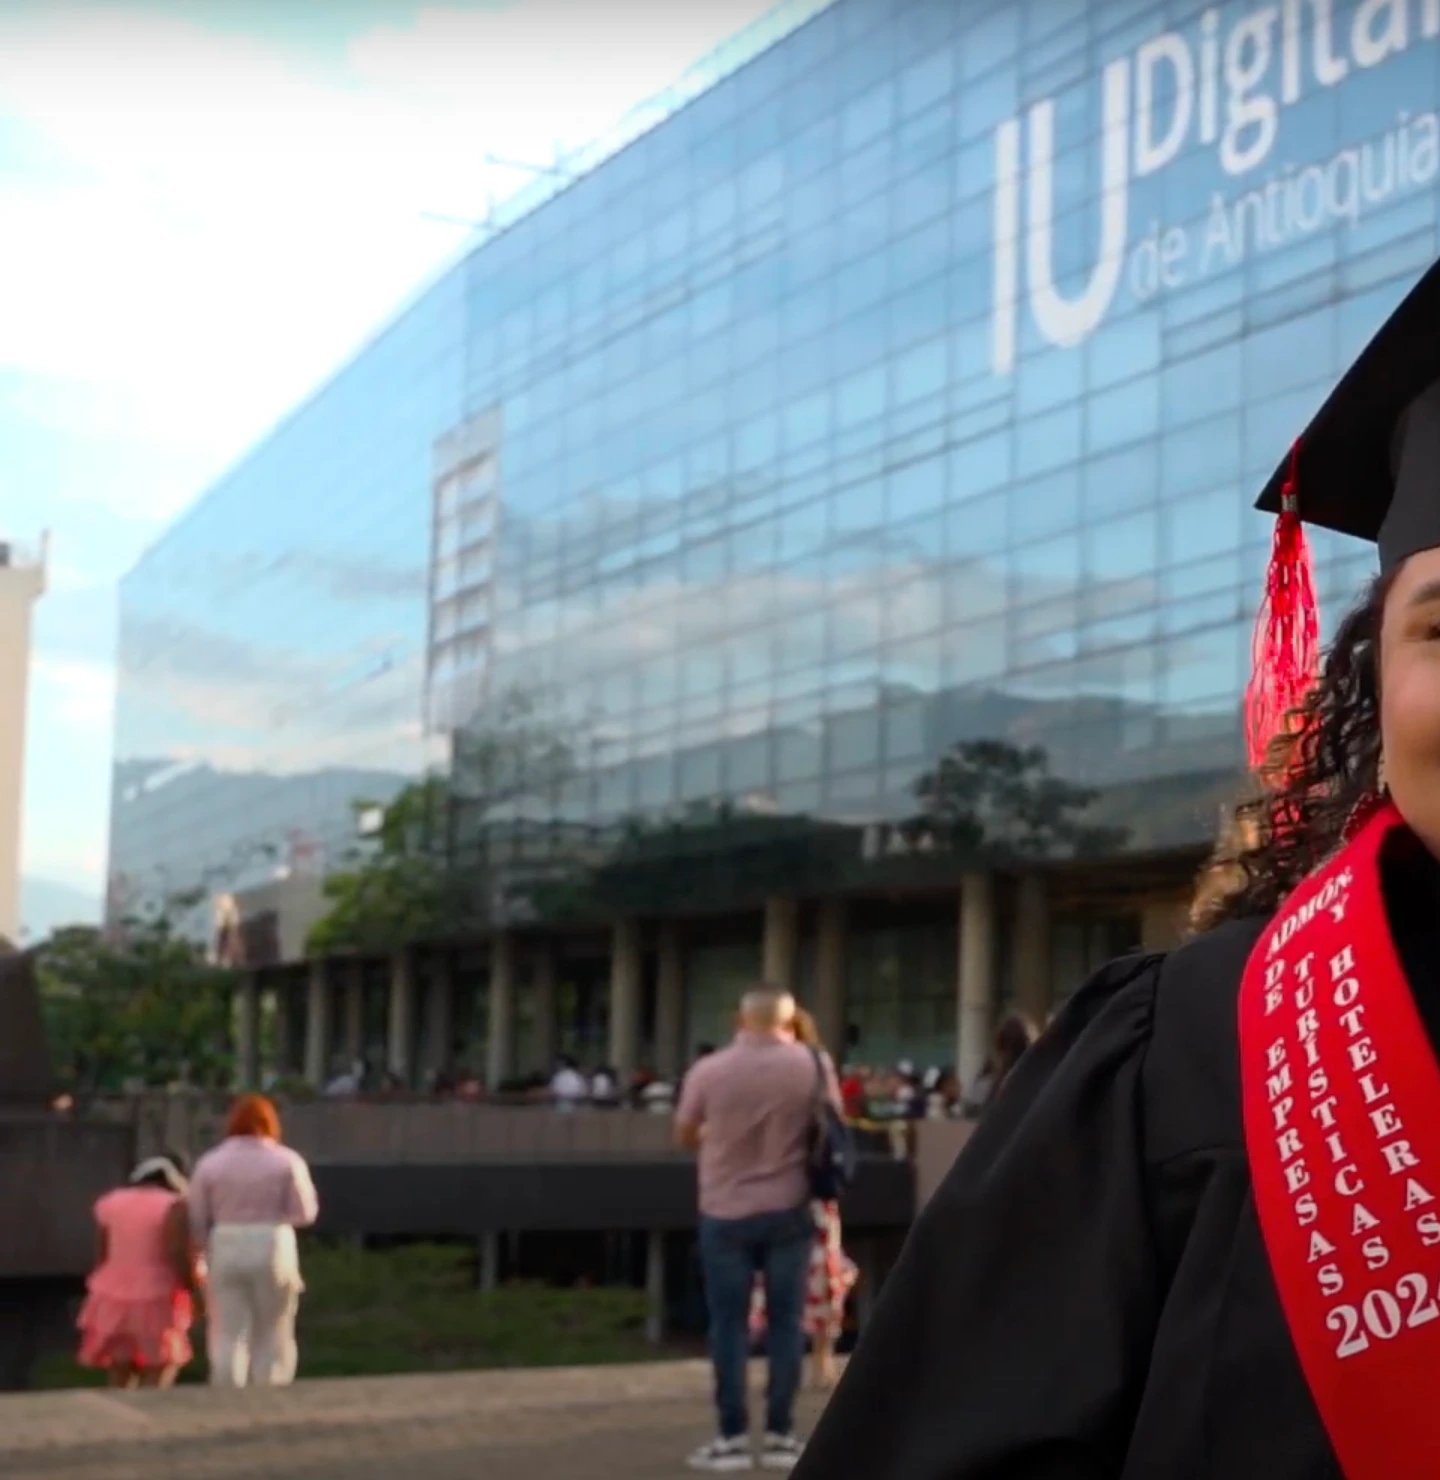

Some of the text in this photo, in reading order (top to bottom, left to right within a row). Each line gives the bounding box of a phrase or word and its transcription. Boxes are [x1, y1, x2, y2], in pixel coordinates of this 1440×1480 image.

[1135, 0, 1440, 176] Digita
[1130, 109, 1440, 299] de Antioquia
[1329, 893, 1350, 924] Y
[1264, 958, 1344, 1296] DE EMPRESAS
[1294, 952, 1390, 1270] TURÍSTICAS
